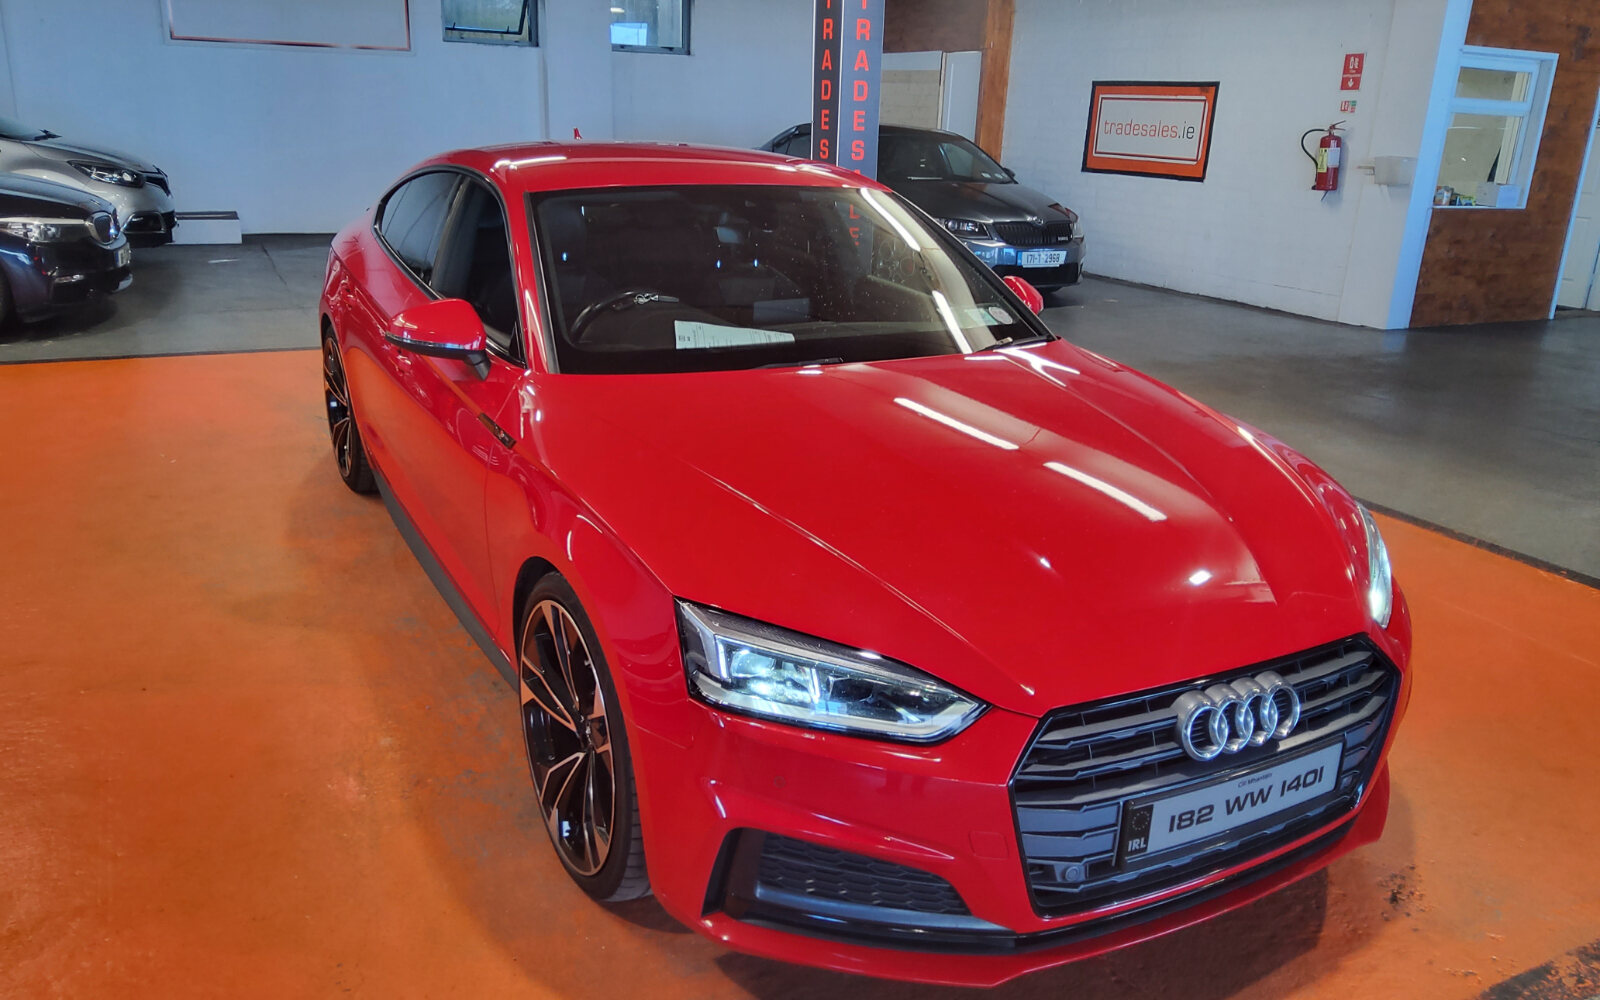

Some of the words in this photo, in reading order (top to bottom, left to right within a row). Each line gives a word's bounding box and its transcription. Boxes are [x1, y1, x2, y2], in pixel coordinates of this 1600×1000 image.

[851, 0, 871, 174] RADES
[1103, 118, 1195, 140] tradesales.ie
[1168, 804, 1215, 833] 182
[1225, 784, 1274, 815] WW
[1280, 766, 1325, 797] 1401
[1128, 837, 1146, 852] IRL
